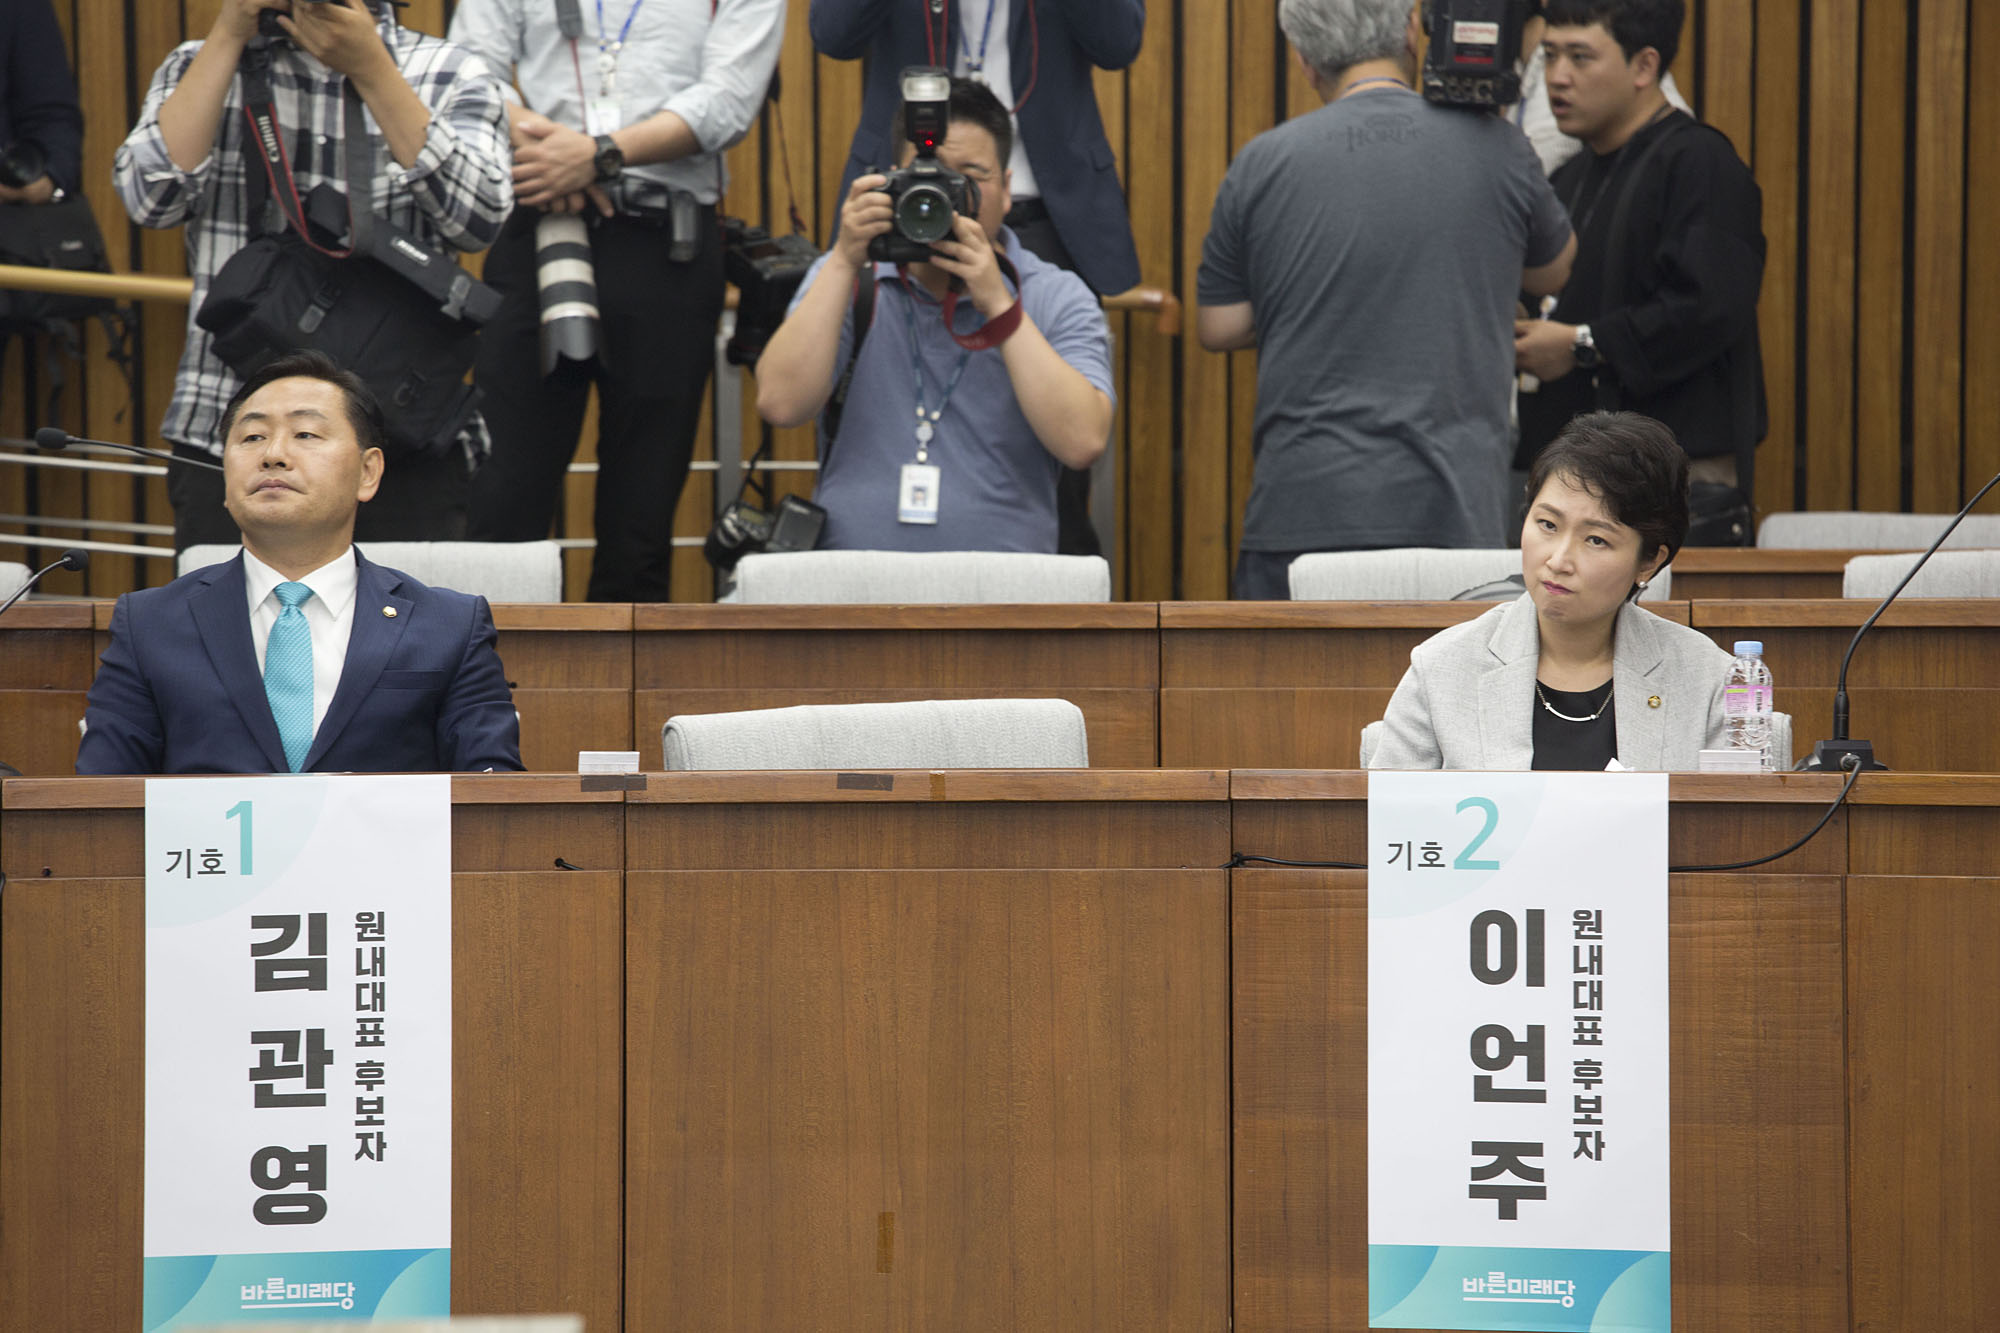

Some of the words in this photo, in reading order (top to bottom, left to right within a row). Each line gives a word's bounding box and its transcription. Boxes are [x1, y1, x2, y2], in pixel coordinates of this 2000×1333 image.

[165, 848, 226, 879] 기호
[225, 801, 254, 877] 1
[1386, 840, 1446, 871] 기호
[1453, 797, 1501, 871] 2
[354, 911, 386, 1048] 원내대표
[1571, 909, 1604, 1046] 원내대표
[248, 912, 334, 1226] 김관영
[354, 1059, 387, 1162] 후보자
[1468, 908, 1548, 1221] 이언주
[1572, 1058, 1606, 1162] 후보자
[240, 1277, 356, 1310] 바른미래당
[1462, 1271, 1576, 1308] 바른미래당
